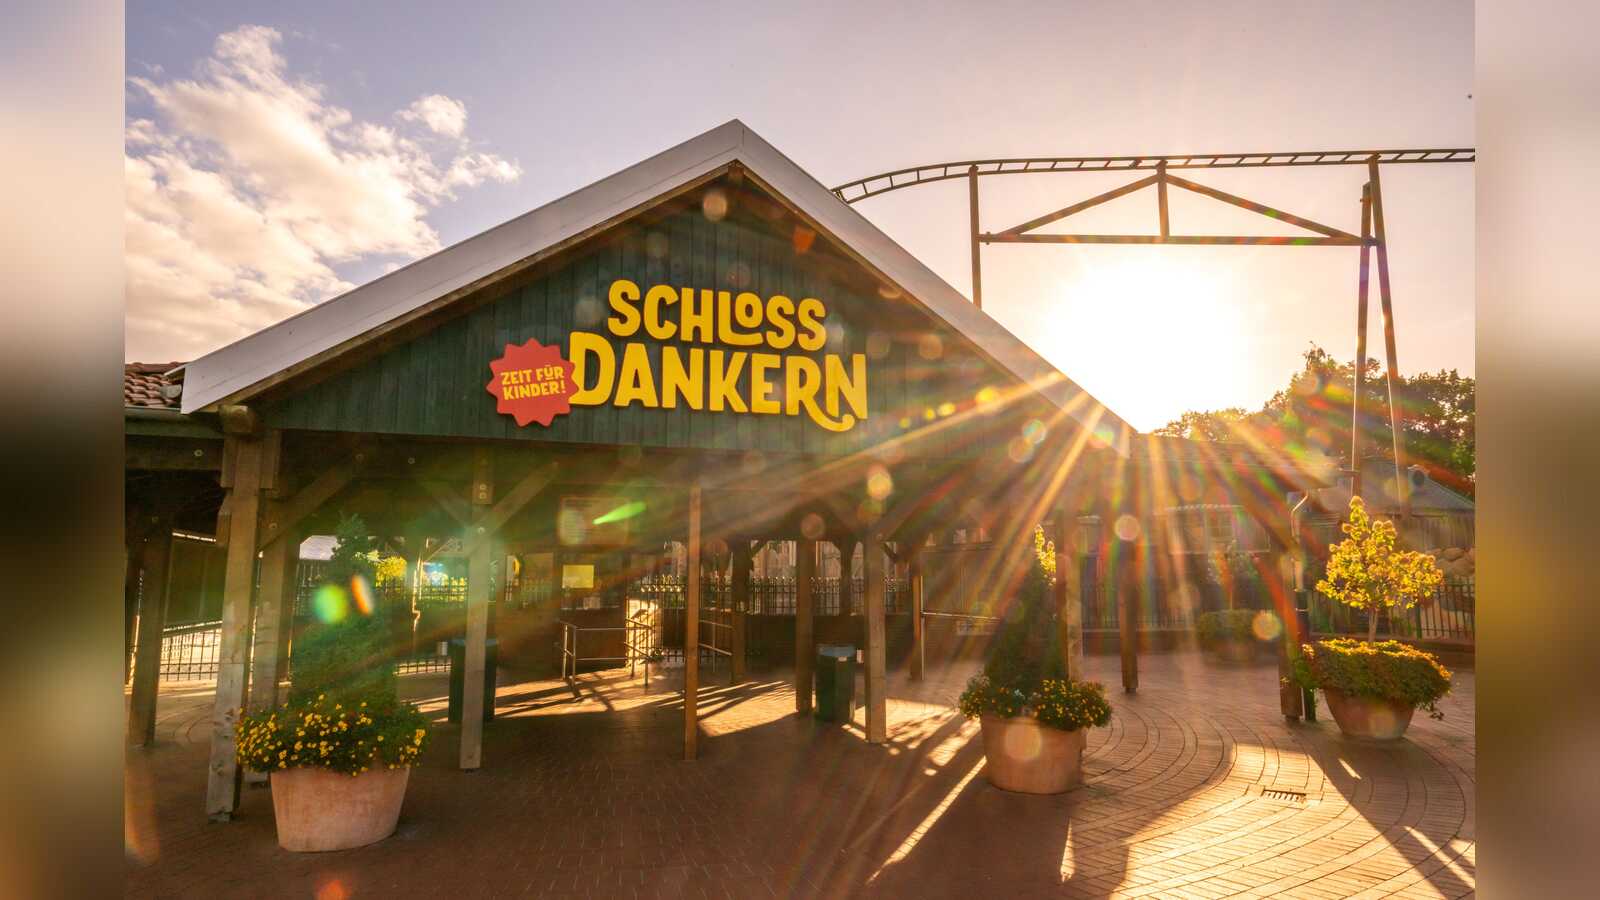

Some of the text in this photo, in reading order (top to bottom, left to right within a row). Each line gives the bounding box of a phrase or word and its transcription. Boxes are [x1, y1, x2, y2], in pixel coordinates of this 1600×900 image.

[607, 279, 827, 351] SCHLOSS
[500, 364, 565, 385] ZEIT FÜR
[502, 379, 567, 401] KINDER!
[568, 331, 868, 432] DANKERN
